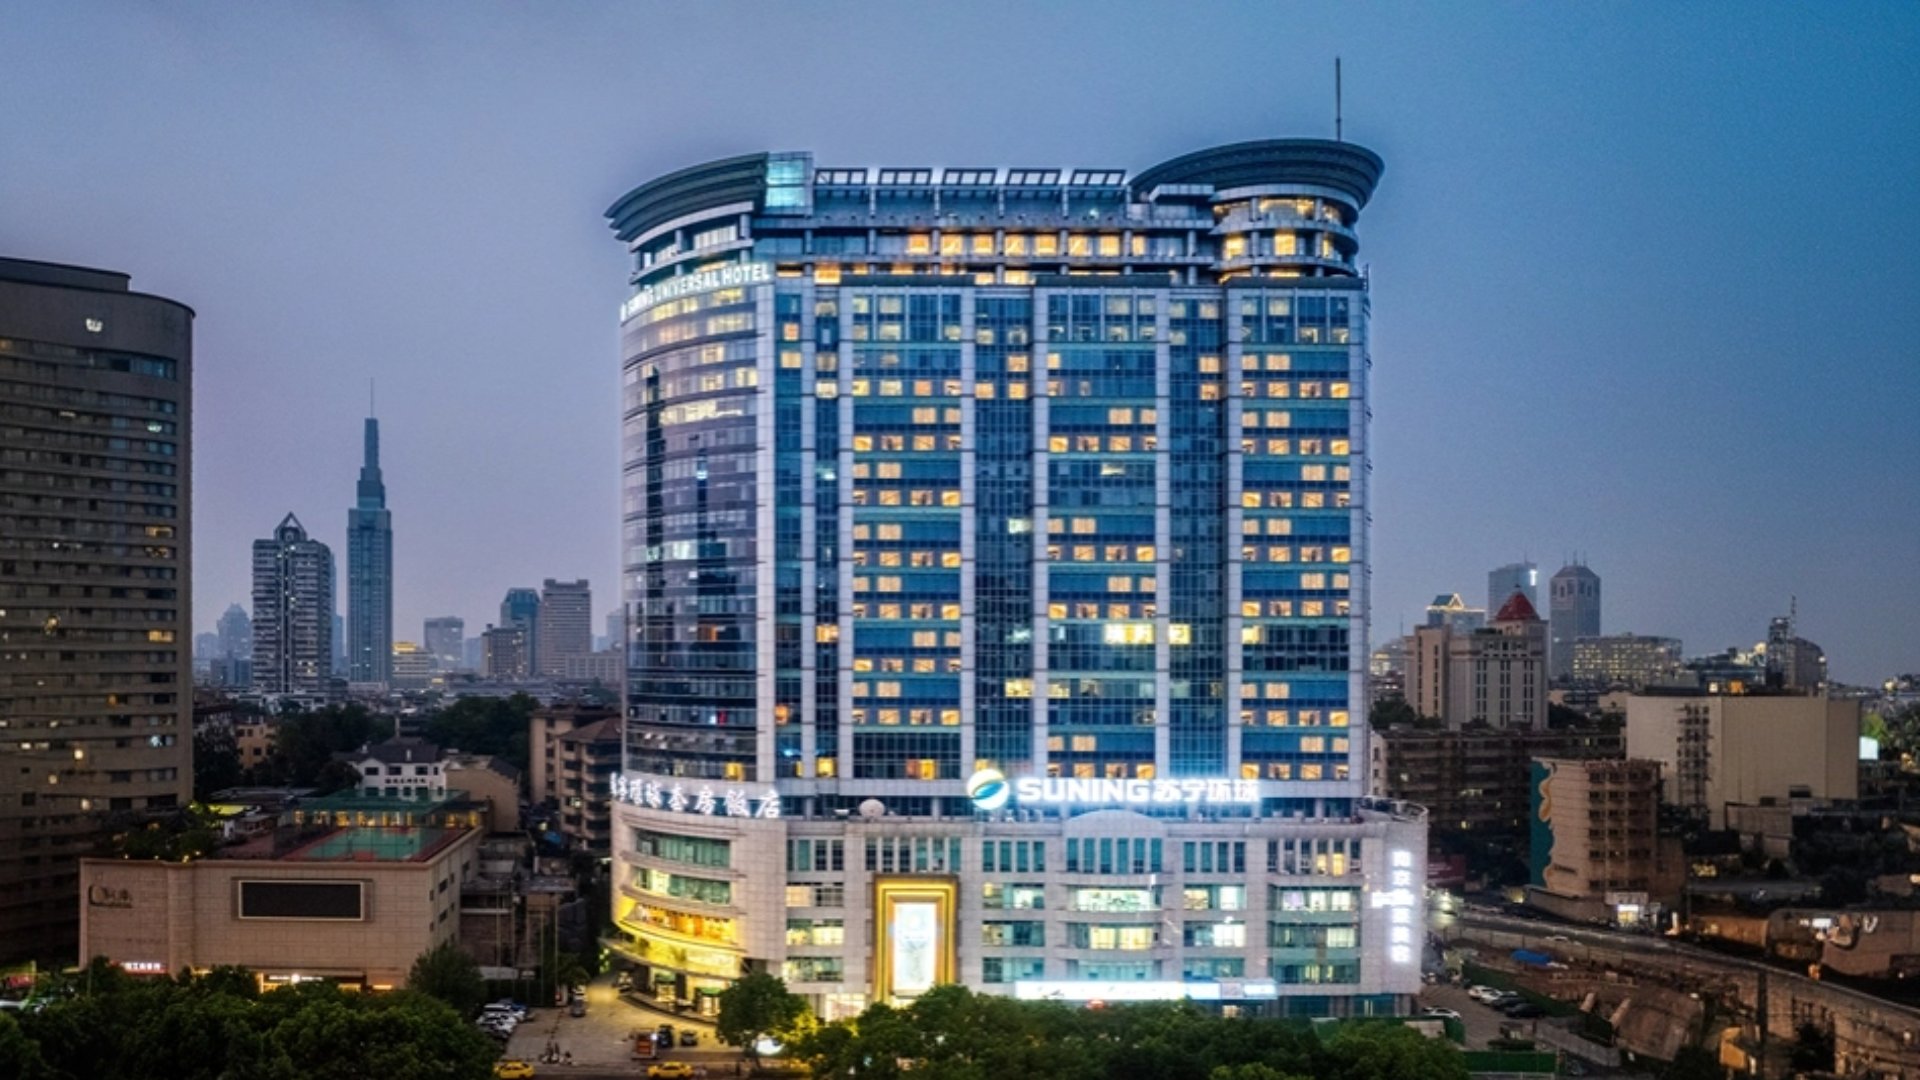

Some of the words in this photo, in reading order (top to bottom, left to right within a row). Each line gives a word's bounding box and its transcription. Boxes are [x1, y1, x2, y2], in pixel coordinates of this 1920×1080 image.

[655, 271, 720, 301] UNIVERSAL
[722, 264, 770, 284] HOTEL
[1017, 779, 1149, 802] SUNING
